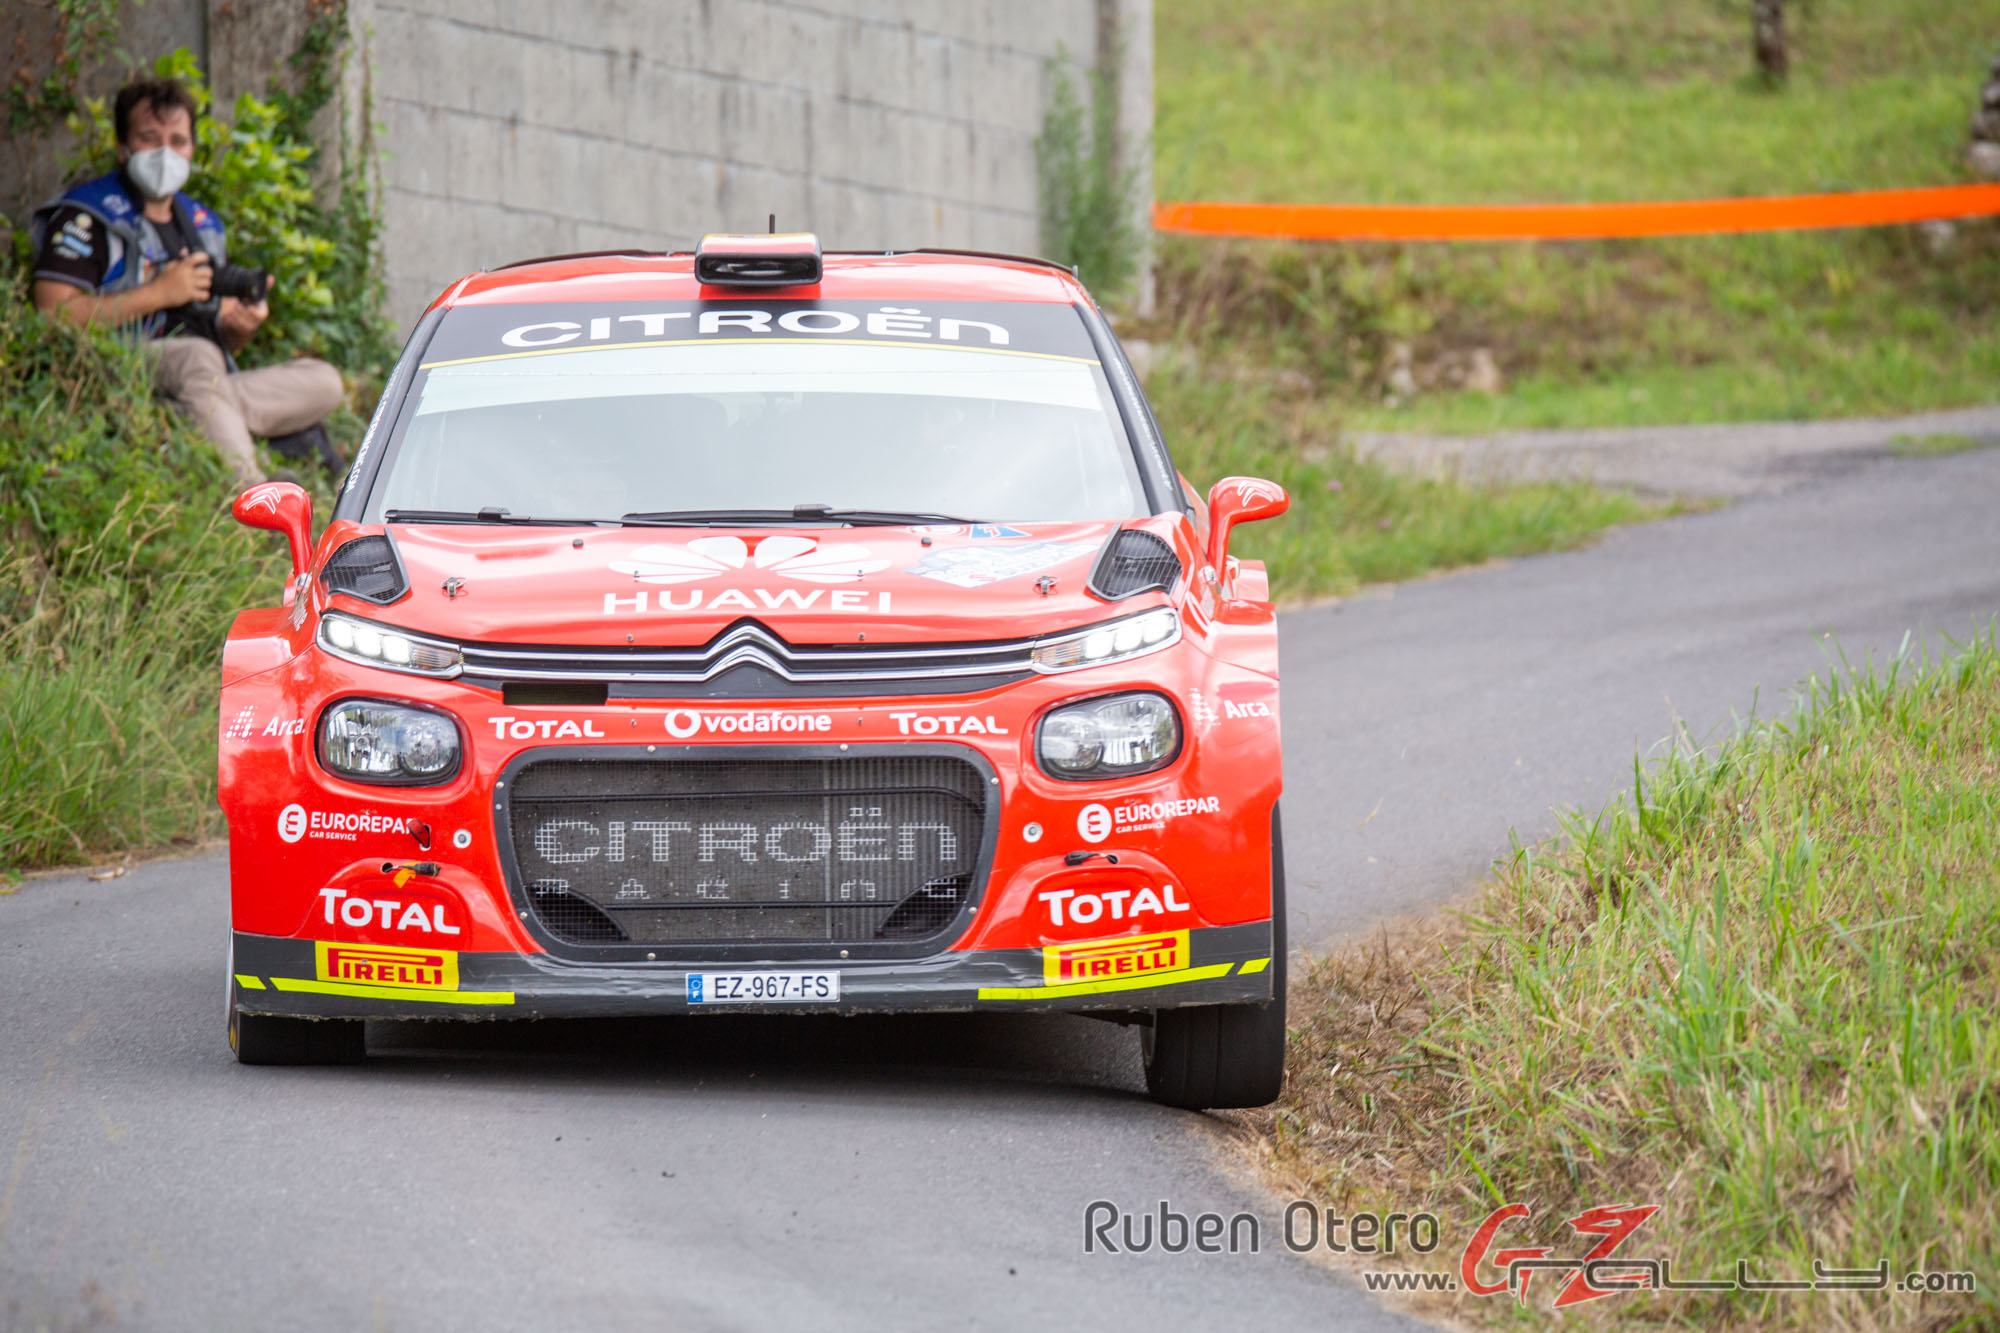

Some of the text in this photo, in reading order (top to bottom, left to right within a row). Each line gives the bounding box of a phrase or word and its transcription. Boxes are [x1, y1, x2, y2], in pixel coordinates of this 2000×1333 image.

[603, 588, 892, 616] HUAWEI
[488, 716, 605, 740] TOTAL
[703, 711, 832, 733] vodafone
[889, 712, 1009, 735] TOTAL
[1114, 796, 1221, 823] EUROREPAR
[309, 830, 357, 841] CAR SERVICE
[1115, 821, 1166, 834] CAR SERVICE
[318, 888, 461, 935] TOTAL
[1038, 885, 1190, 926] TOTAL
[327, 947, 444, 985] PIRELLI
[1059, 937, 1177, 980] PIRELLI
[714, 975, 829, 998] EZ-967-FS
